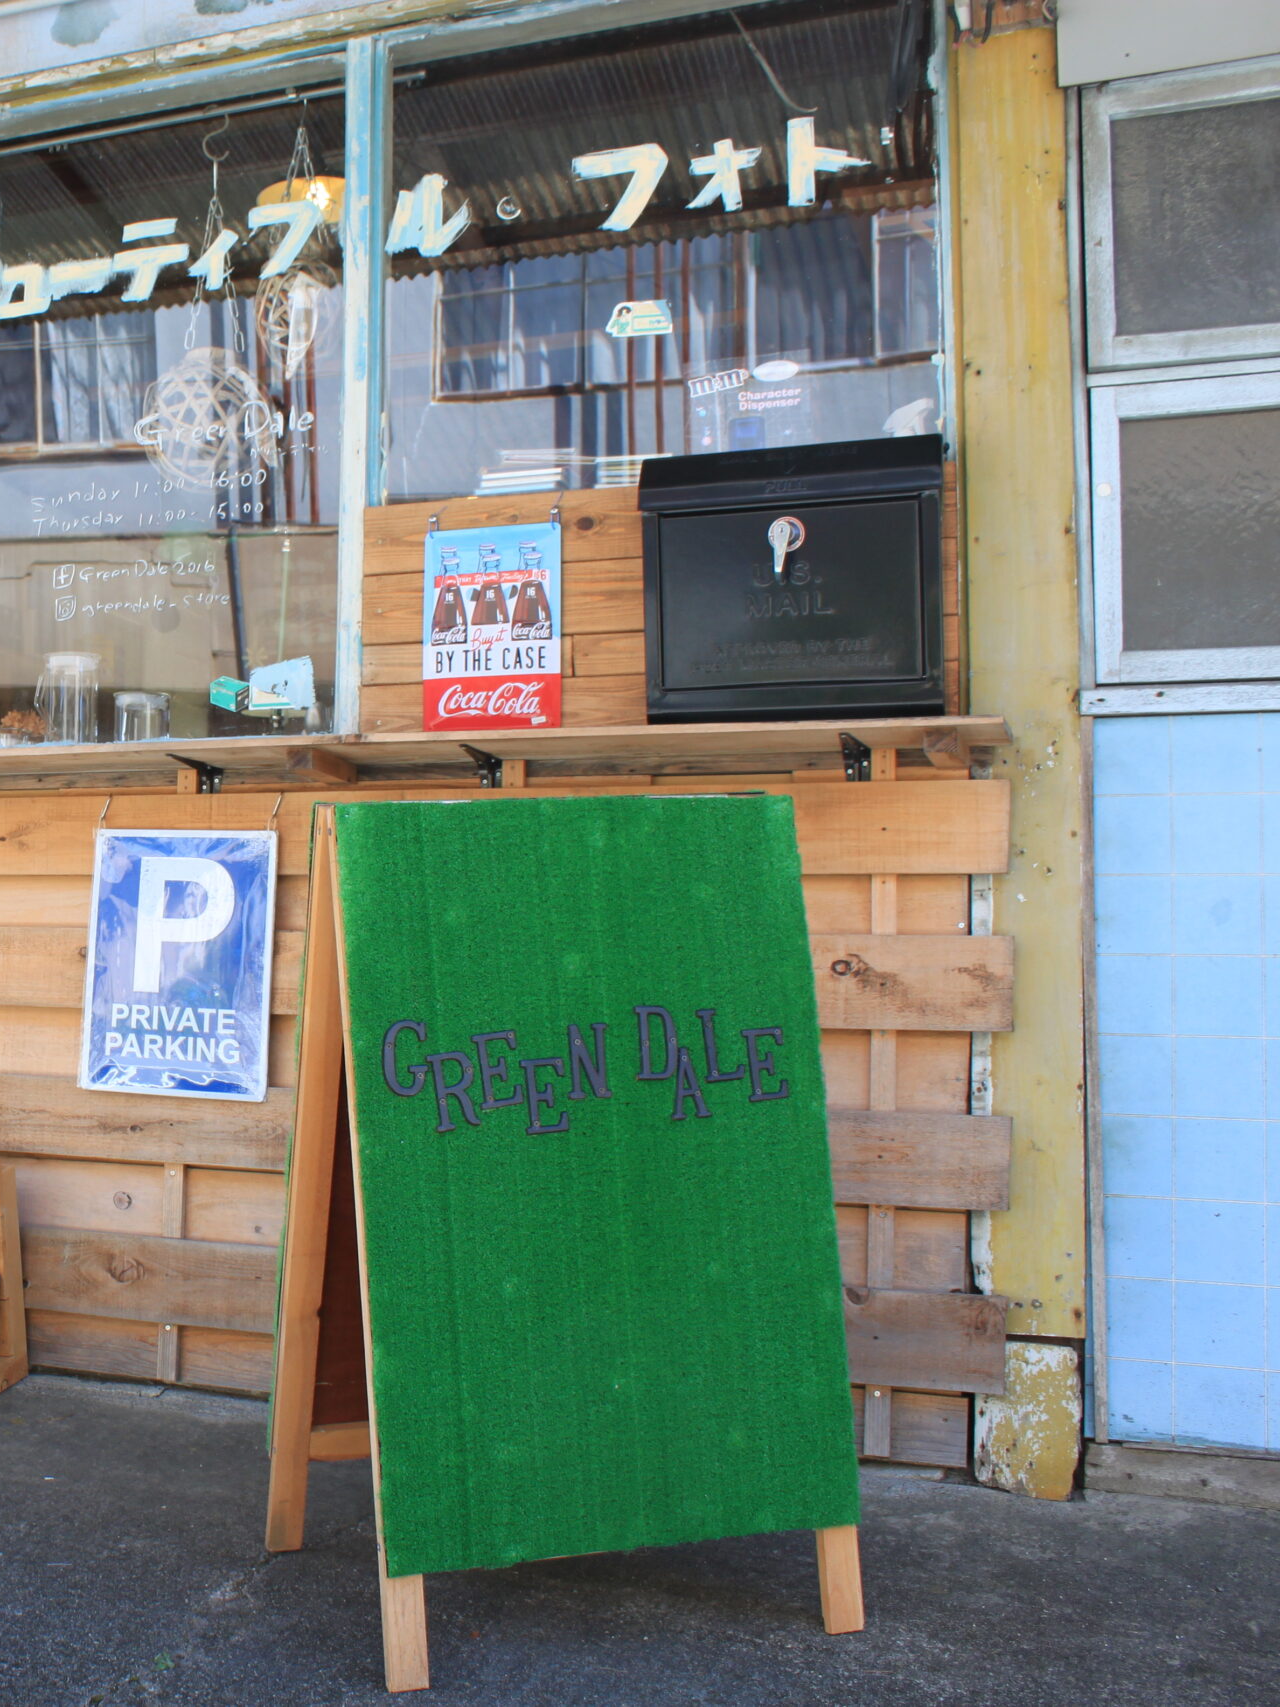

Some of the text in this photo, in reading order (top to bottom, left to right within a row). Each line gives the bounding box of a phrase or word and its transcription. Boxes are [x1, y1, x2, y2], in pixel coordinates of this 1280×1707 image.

[738, 388, 801, 401] Character
[739, 398, 801, 411] Dispenser
[133, 400, 315, 450] Green Dale
[31, 482, 121, 513] Sunday
[32, 511, 124, 536] Thursday
[744, 590, 835, 618] MAIL
[431, 625, 467, 645] Coca-Cola
[512, 620, 551, 640] Coca-Cola
[435, 645, 547, 674] BY THE CASE
[437, 681, 545, 718] Coca-Cola
[132, 856, 236, 993] P
[110, 1003, 237, 1034] PRIVATE
[104, 1031, 241, 1064] PARKING
[381, 1005, 789, 1135] GREEN DALE
